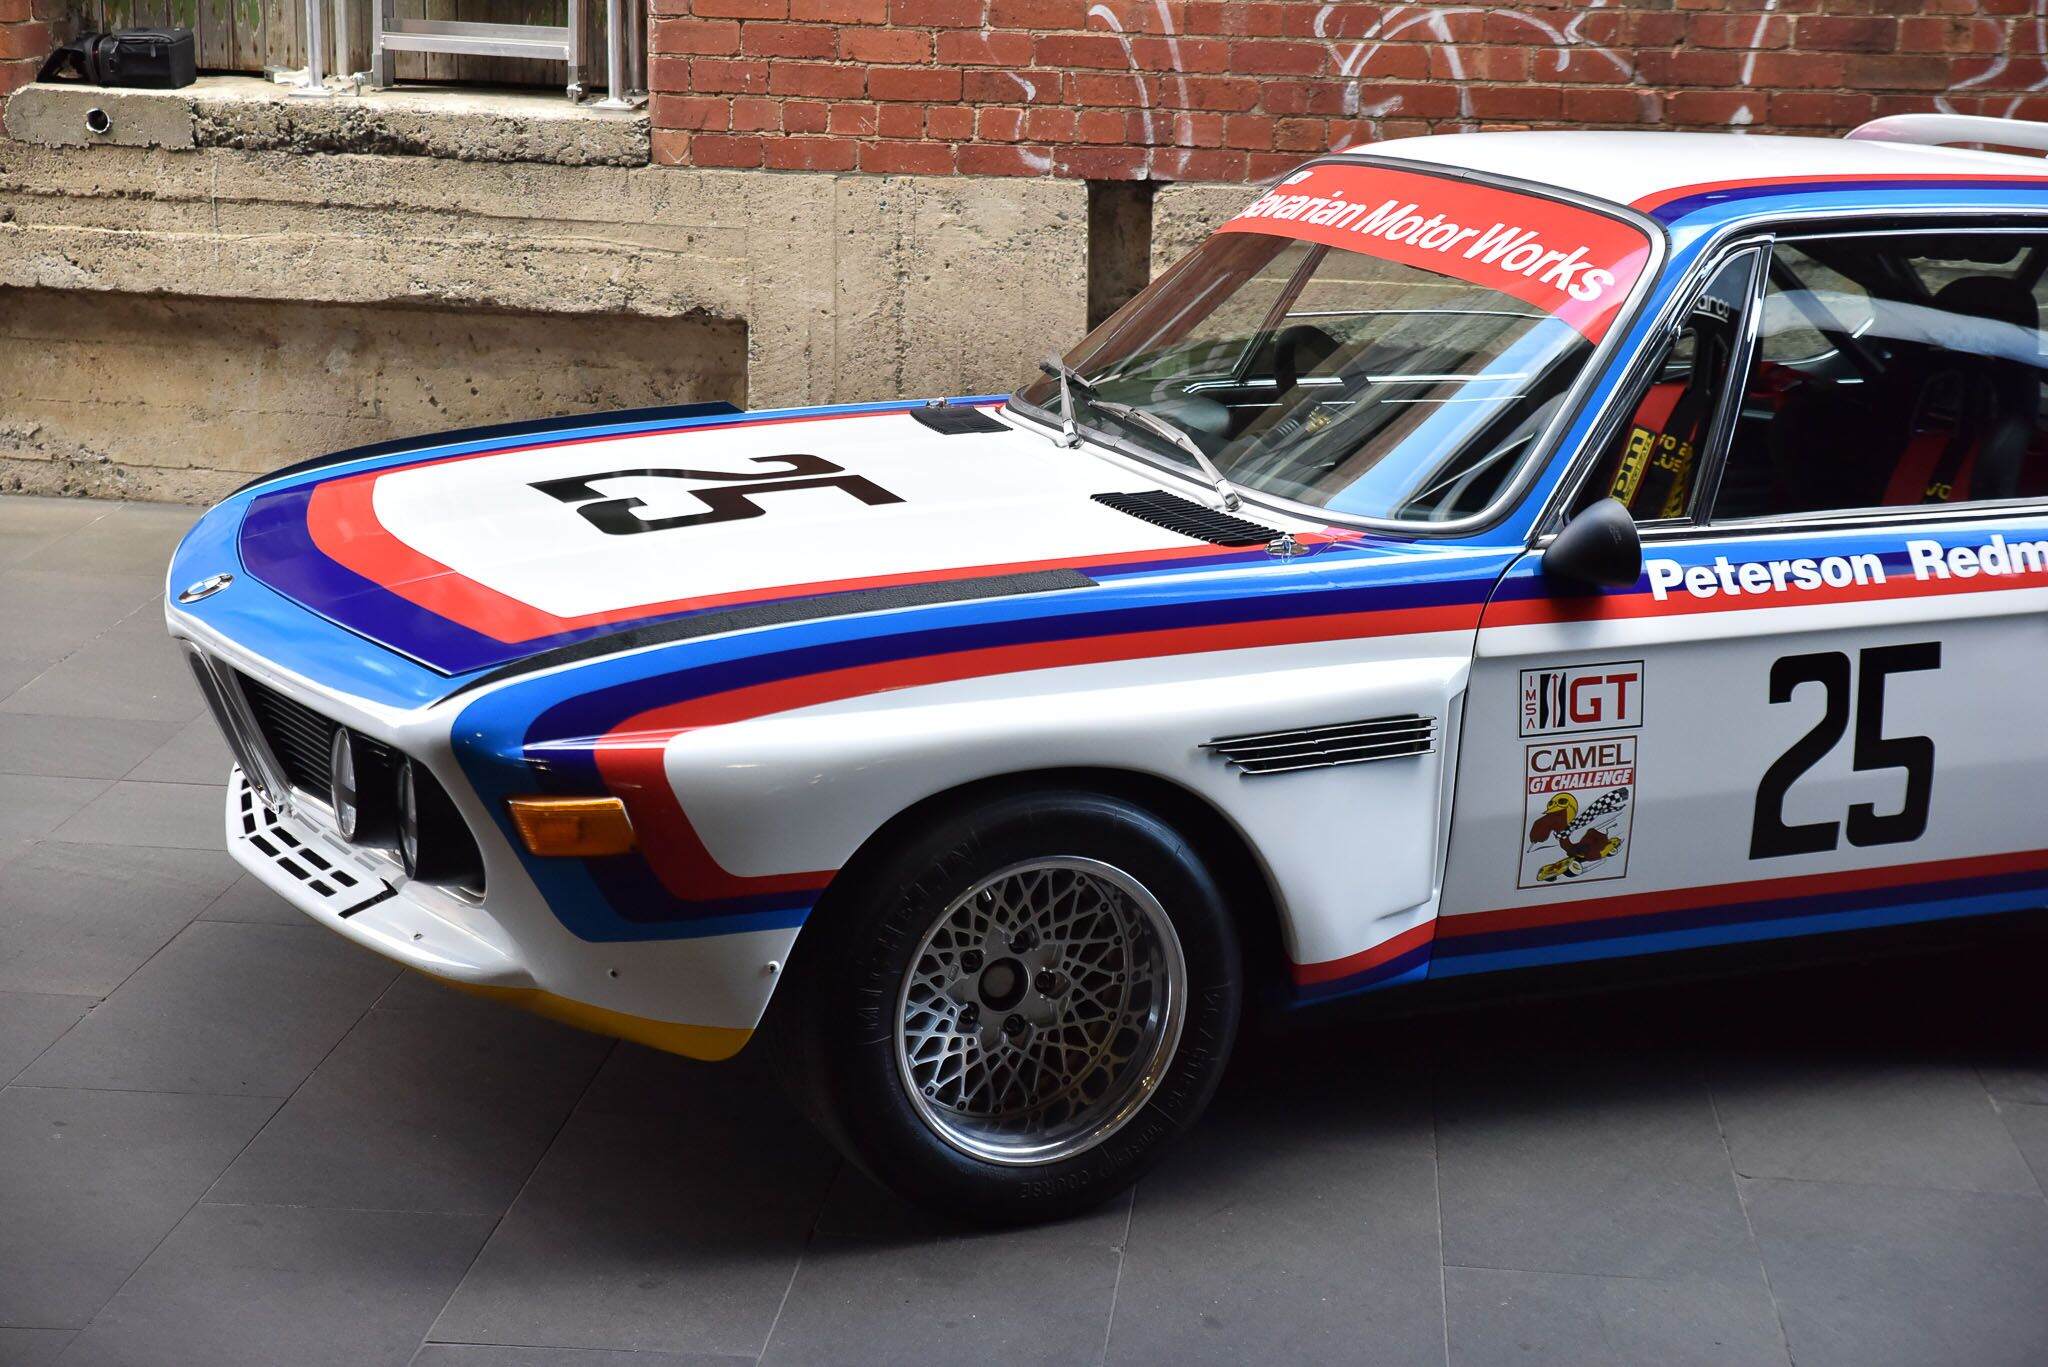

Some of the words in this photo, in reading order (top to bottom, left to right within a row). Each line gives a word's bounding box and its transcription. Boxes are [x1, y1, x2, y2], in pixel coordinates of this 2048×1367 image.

[1350, 198, 1481, 253] Motor
[1462, 222, 1616, 302] Works
[526, 453, 908, 536] 25
[1645, 552, 1887, 602] Peterson
[1906, 533, 2048, 581] Redm
[1570, 673, 1637, 723] GT
[1530, 776, 1549, 793] GT
[1552, 769, 1631, 790] CHALLENGE
[1531, 744, 1632, 772] CAMEL
[1749, 640, 1942, 861] 25
